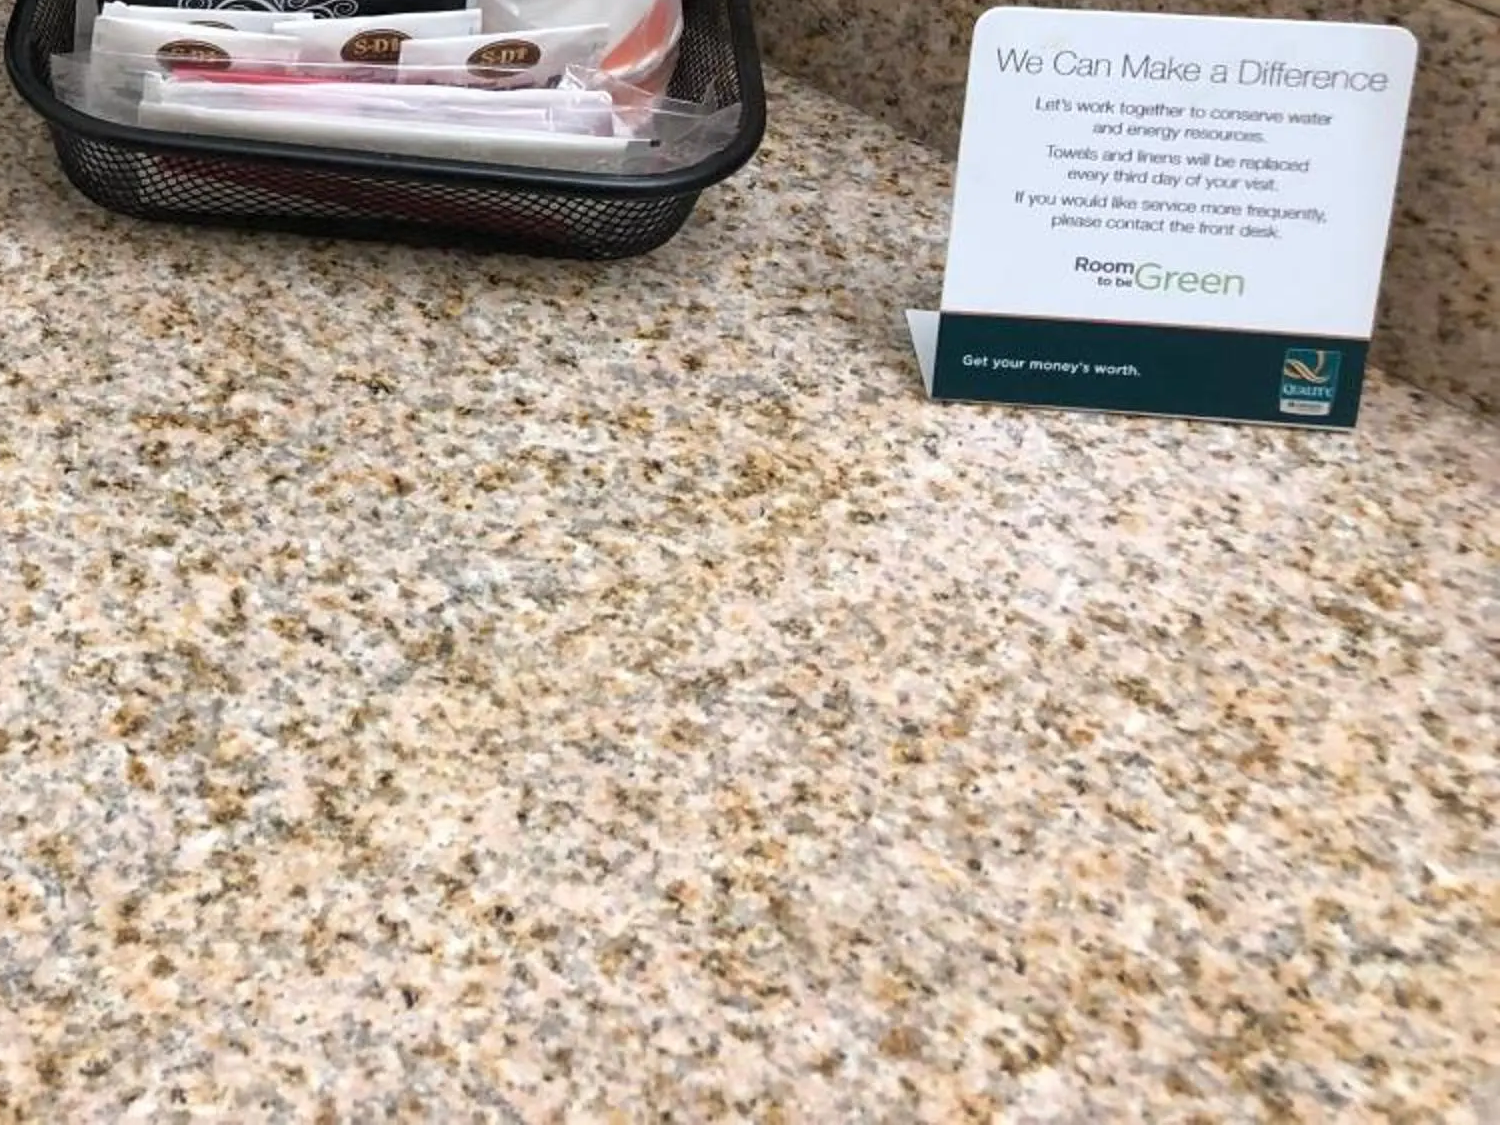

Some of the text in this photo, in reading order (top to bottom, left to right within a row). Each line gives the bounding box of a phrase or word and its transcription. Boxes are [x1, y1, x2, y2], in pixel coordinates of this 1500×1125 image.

[997, 47, 1389, 92] We Can Make a Difference
[1035, 96, 1333, 126] Let's work together to conserve water
[1092, 122, 1267, 143] and energy resources.
[1046, 144, 1310, 173] Towels and linens will be replaced
[1067, 170, 1278, 192] every third day of your visit.
[1014, 190, 1327, 224] If you would like service more frequently,
[1051, 213, 1282, 239] please contact the front desk.
[1074, 256, 1246, 297] Room Green
[1097, 276, 1133, 287] to be
[962, 354, 1141, 377] Get your money's worth.
